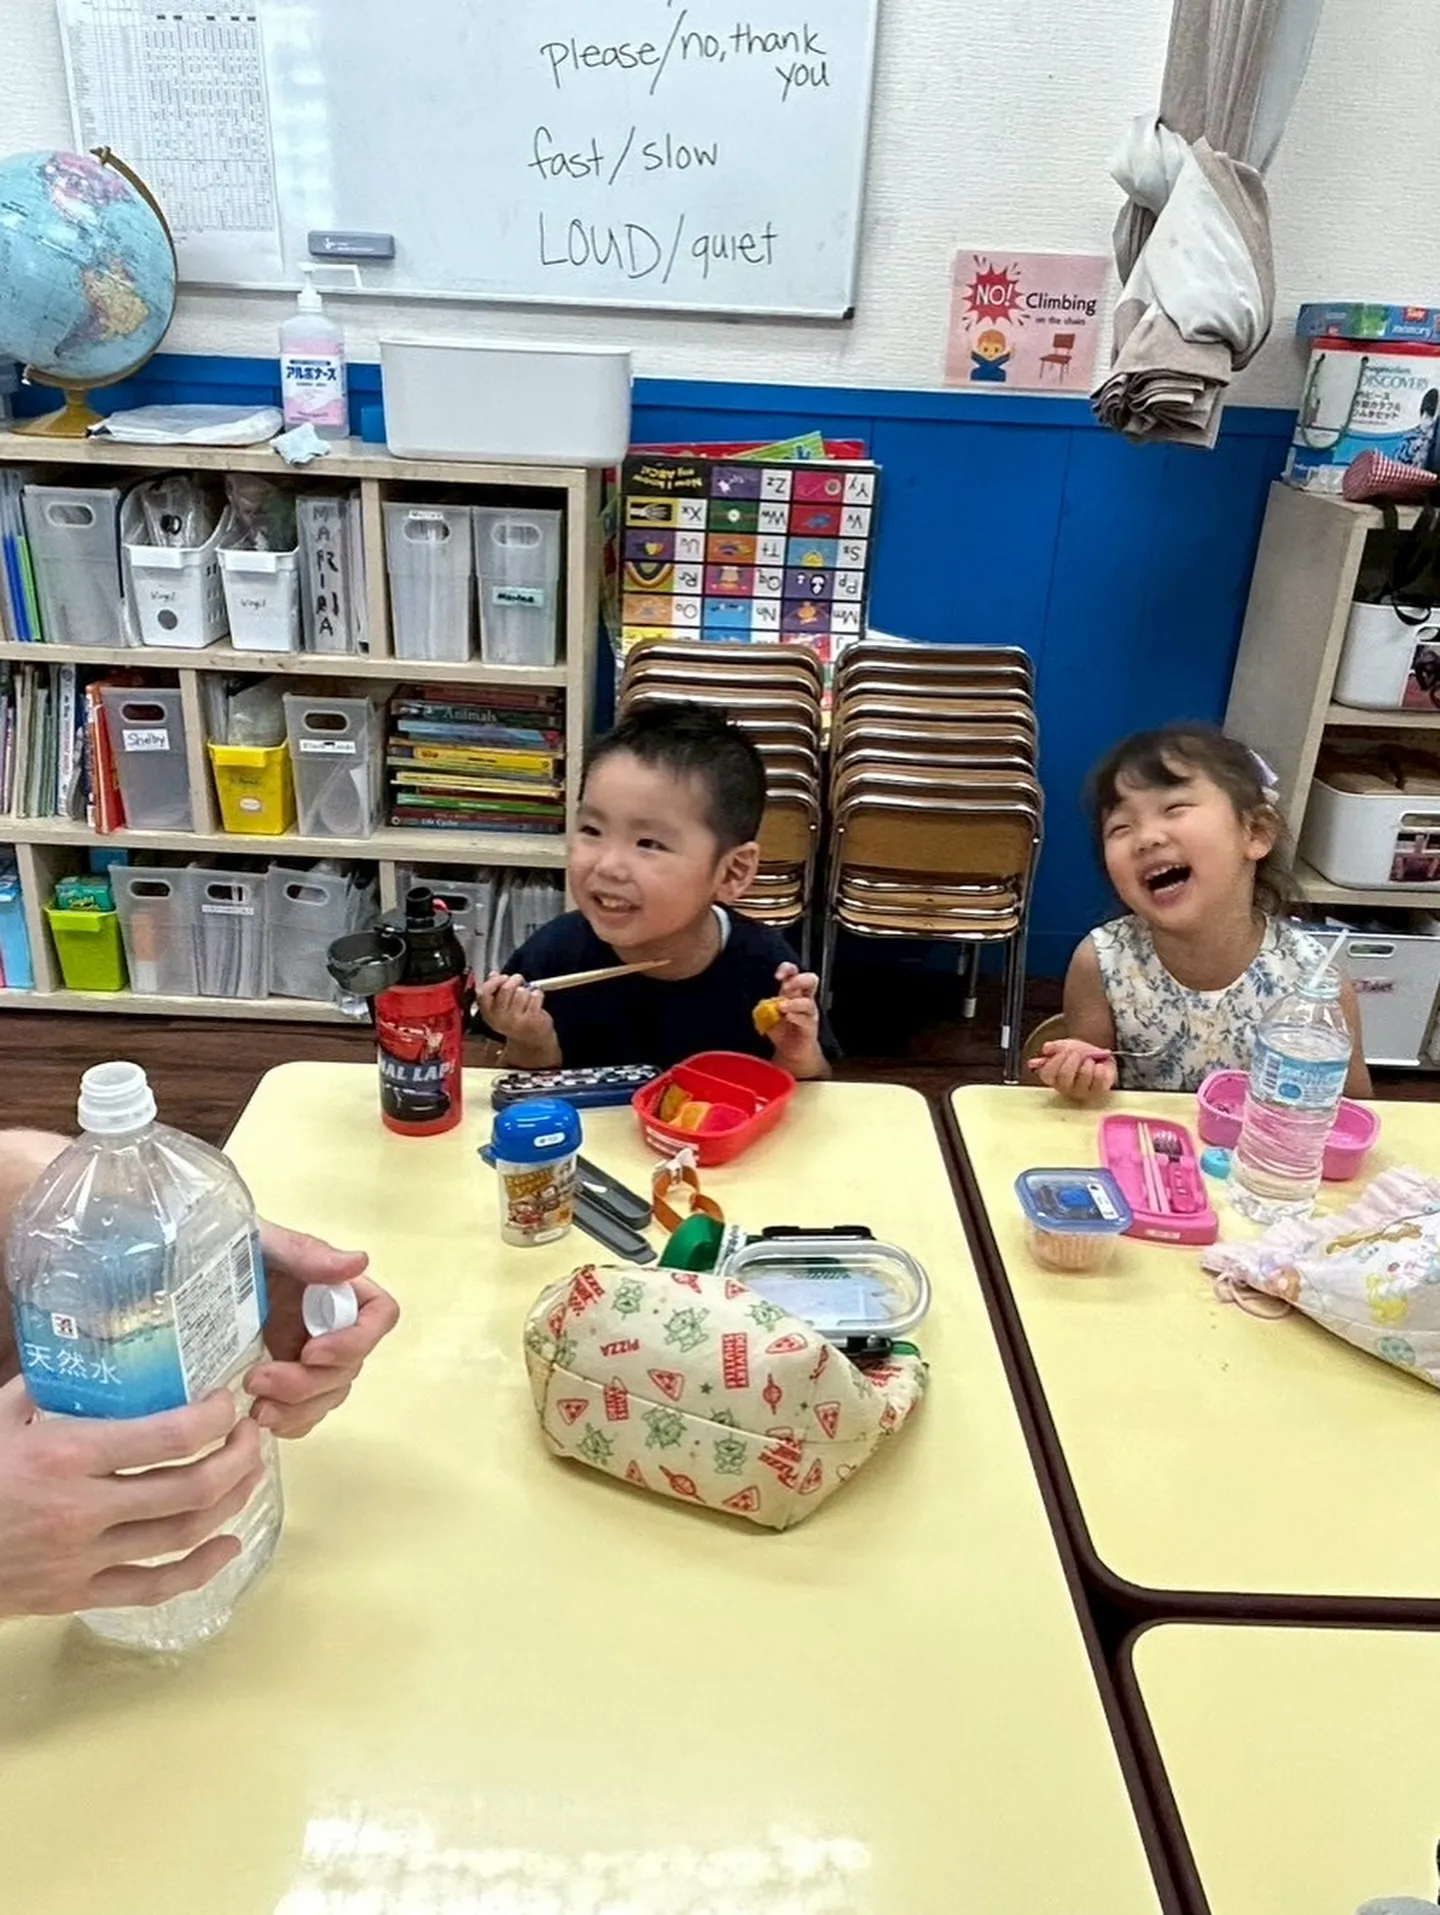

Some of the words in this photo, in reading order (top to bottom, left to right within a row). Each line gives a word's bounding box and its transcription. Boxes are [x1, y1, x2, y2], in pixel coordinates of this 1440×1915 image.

[775, 61, 830, 102] you
[976, 284, 1013, 307] NO!
[1025, 292, 1097, 316] Climbing
[767, 477, 787, 494] Zz
[849, 477, 868, 497] Yy
[682, 507, 702, 522] Xx
[763, 542, 780, 558] Tt
[843, 546, 860, 561] Ss
[678, 571, 698, 588] Rr
[838, 578, 858, 595] Pp
[676, 604, 697, 619] Oo
[757, 607, 776, 621] Nn
[834, 609, 858, 625] Mm
[444, 706, 498, 722] Animals
[127, 732, 166, 748] Shelby
[600, 1338, 639, 1357] PIZZA
[24, 1342, 122, 1386] 天然水
